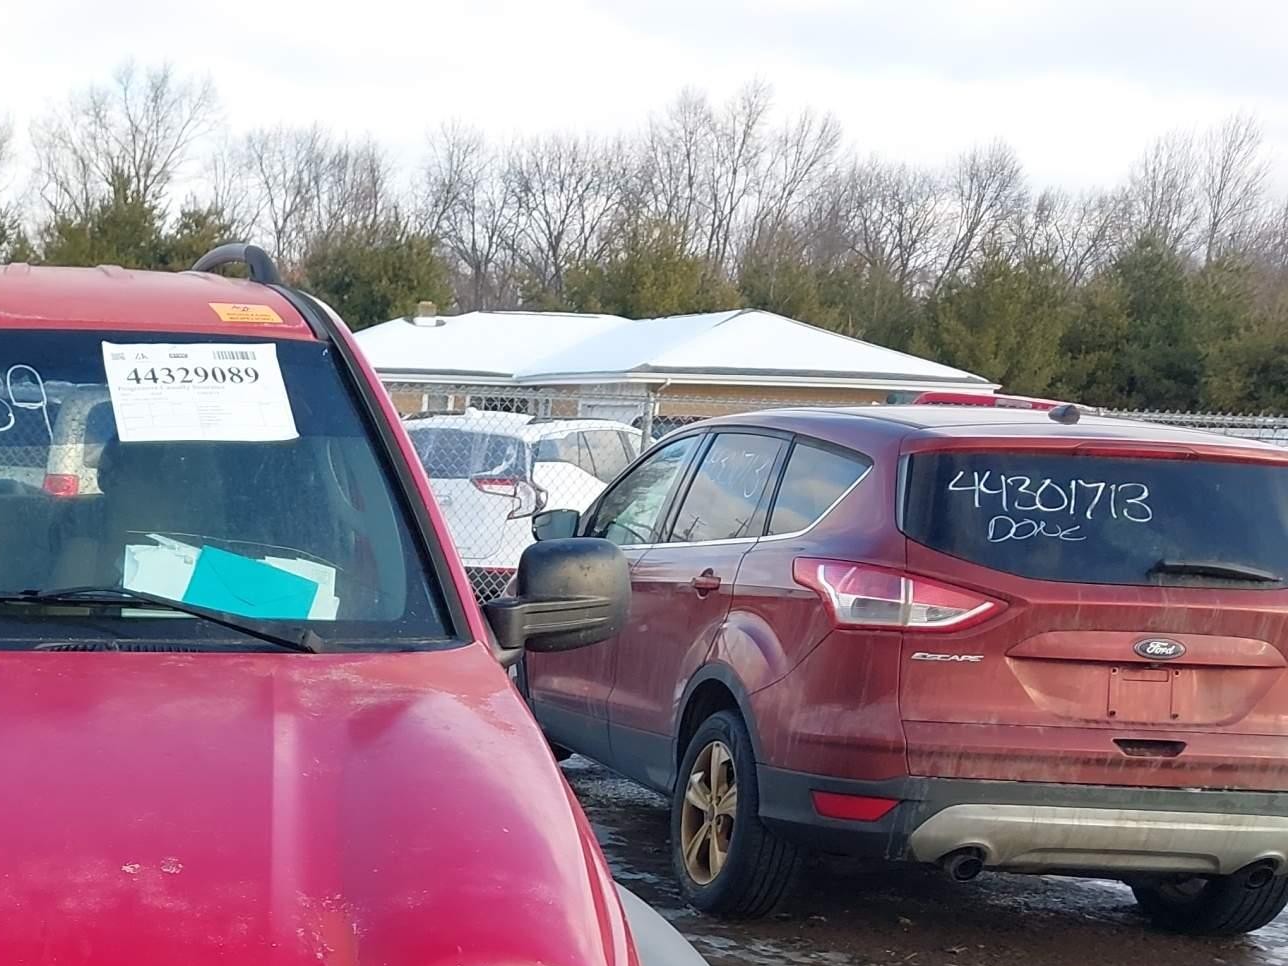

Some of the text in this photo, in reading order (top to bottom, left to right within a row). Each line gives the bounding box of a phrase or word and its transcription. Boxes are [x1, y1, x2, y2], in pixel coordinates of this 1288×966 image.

[126, 366, 259, 384] 44329089
[948, 470, 1153, 522] 44301713
[1146, 641, 1176, 655] Ford
[911, 652, 984, 662] ESCAPE
